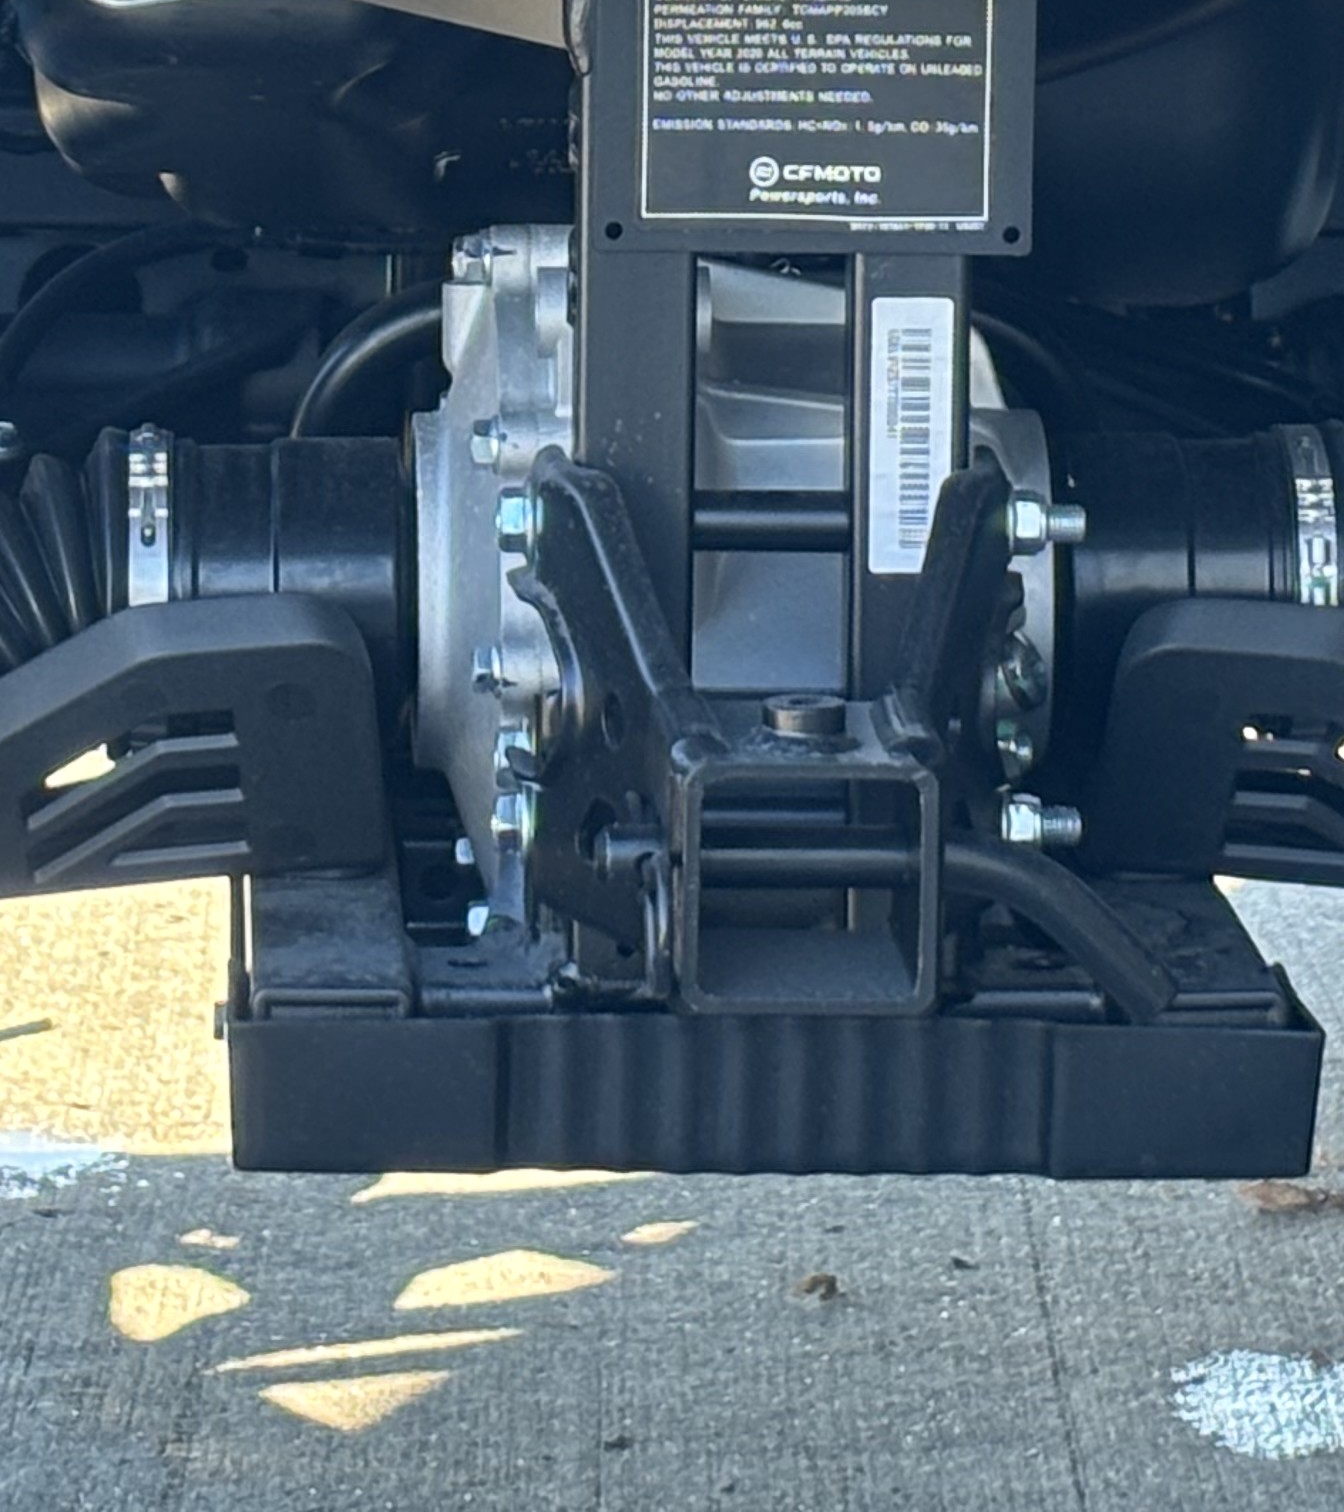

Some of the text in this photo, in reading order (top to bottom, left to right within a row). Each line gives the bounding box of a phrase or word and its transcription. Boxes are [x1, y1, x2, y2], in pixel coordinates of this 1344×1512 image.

[654, 3, 734, 16] PERMEATION
[655, 33, 683, 45] THIS
[687, 33, 739, 45] VEHICLE
[744, 33, 787, 45] MEETS
[826, 33, 851, 46] EPA
[855, 33, 942, 47] REGULATIONS
[946, 34, 972, 48] FOR
[654, 48, 695, 59] MODEL
[700, 48, 732, 59] YEAR
[767, 48, 789, 60] ALL
[794, 48, 846, 60] TERRAIN
[655, 62, 983, 77] THIS VEHICLE IS CERTIFIED TO OPERATE ON UNLEADED
[654, 90, 672, 102] NO
[676, 90, 720, 102] OTHER
[723, 90, 815, 103] ADJUSTMENTS
[653, 119, 713, 131] EMISSION
[783, 165, 881, 183] CFMOTO
[854, 191, 881, 206] Inc.
